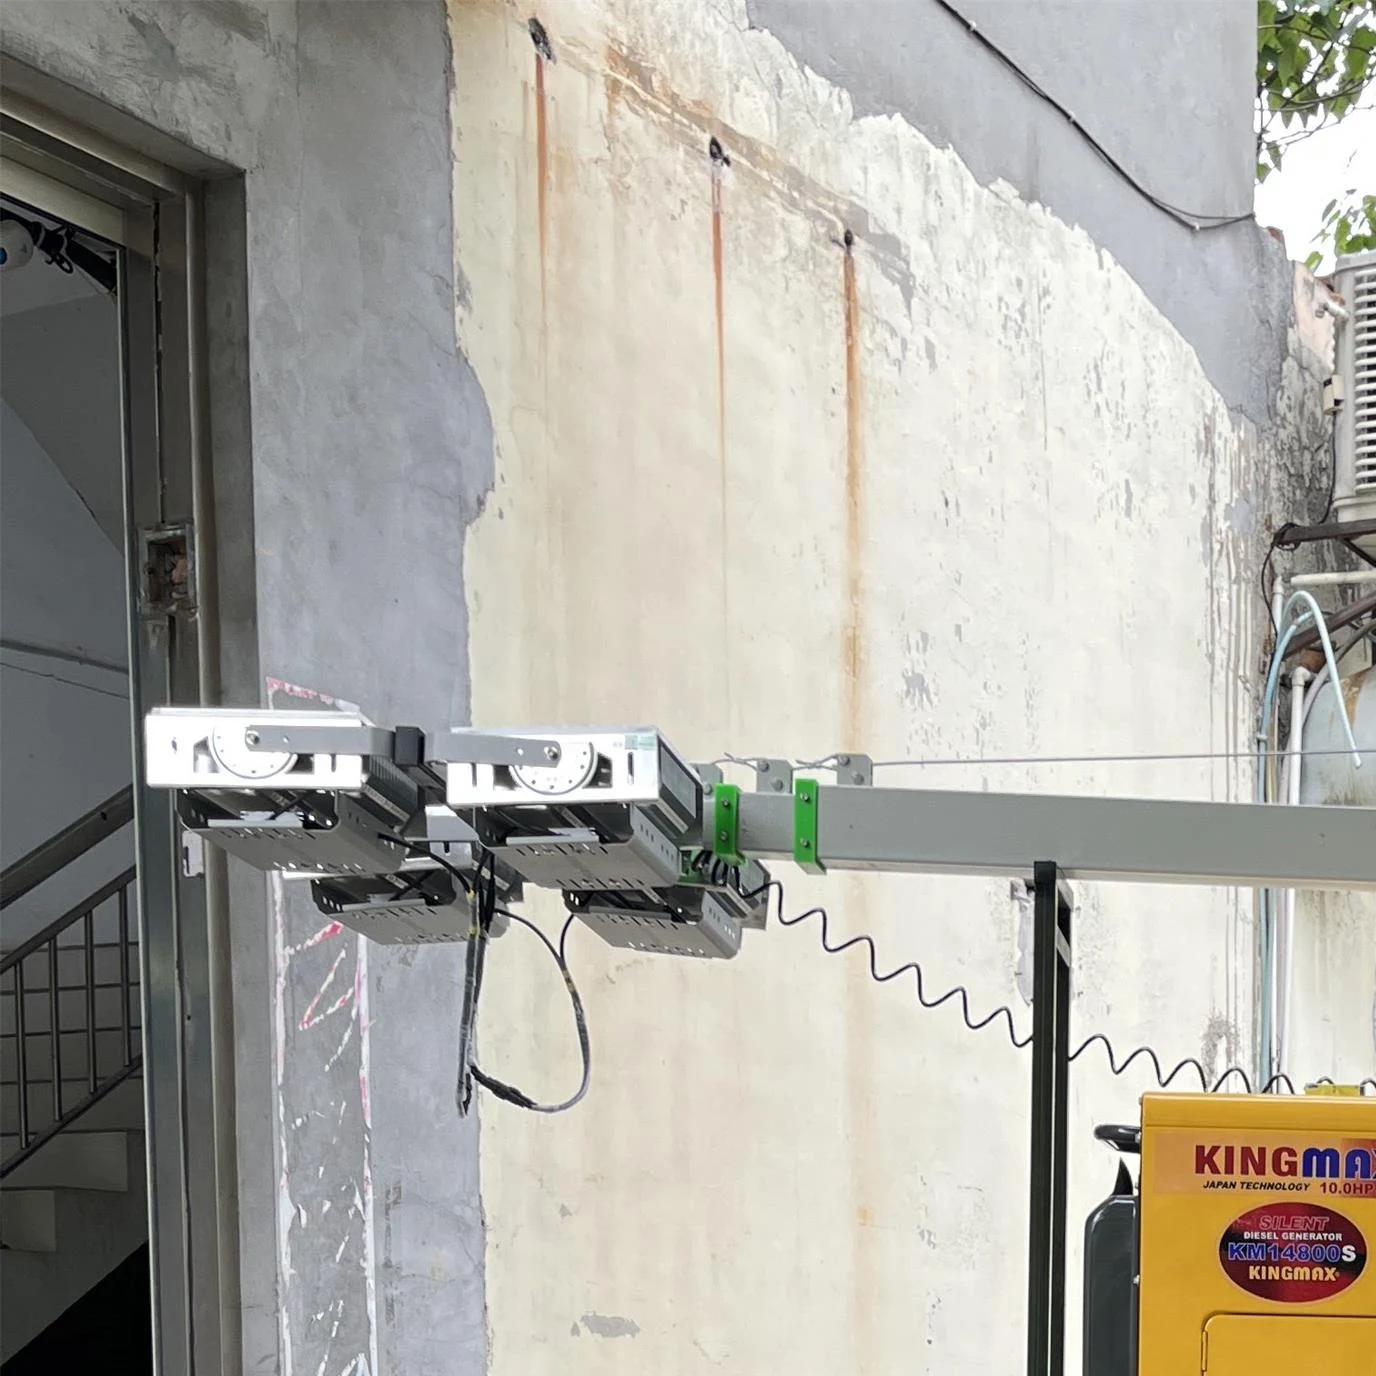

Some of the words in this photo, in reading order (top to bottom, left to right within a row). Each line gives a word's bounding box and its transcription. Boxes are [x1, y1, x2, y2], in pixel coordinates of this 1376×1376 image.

[1203, 1180, 1237, 1190] JAPAN
[1240, 1181, 1311, 1192] TECHNOLOGY
[1320, 1181, 1375, 1195] 10.0HP
[1258, 1214, 1330, 1231] SILENT
[1243, 1231, 1279, 1241] DIESEL
[1281, 1231, 1343, 1242] GENERATOR
[1227, 1243, 1357, 1263] KM14800S
